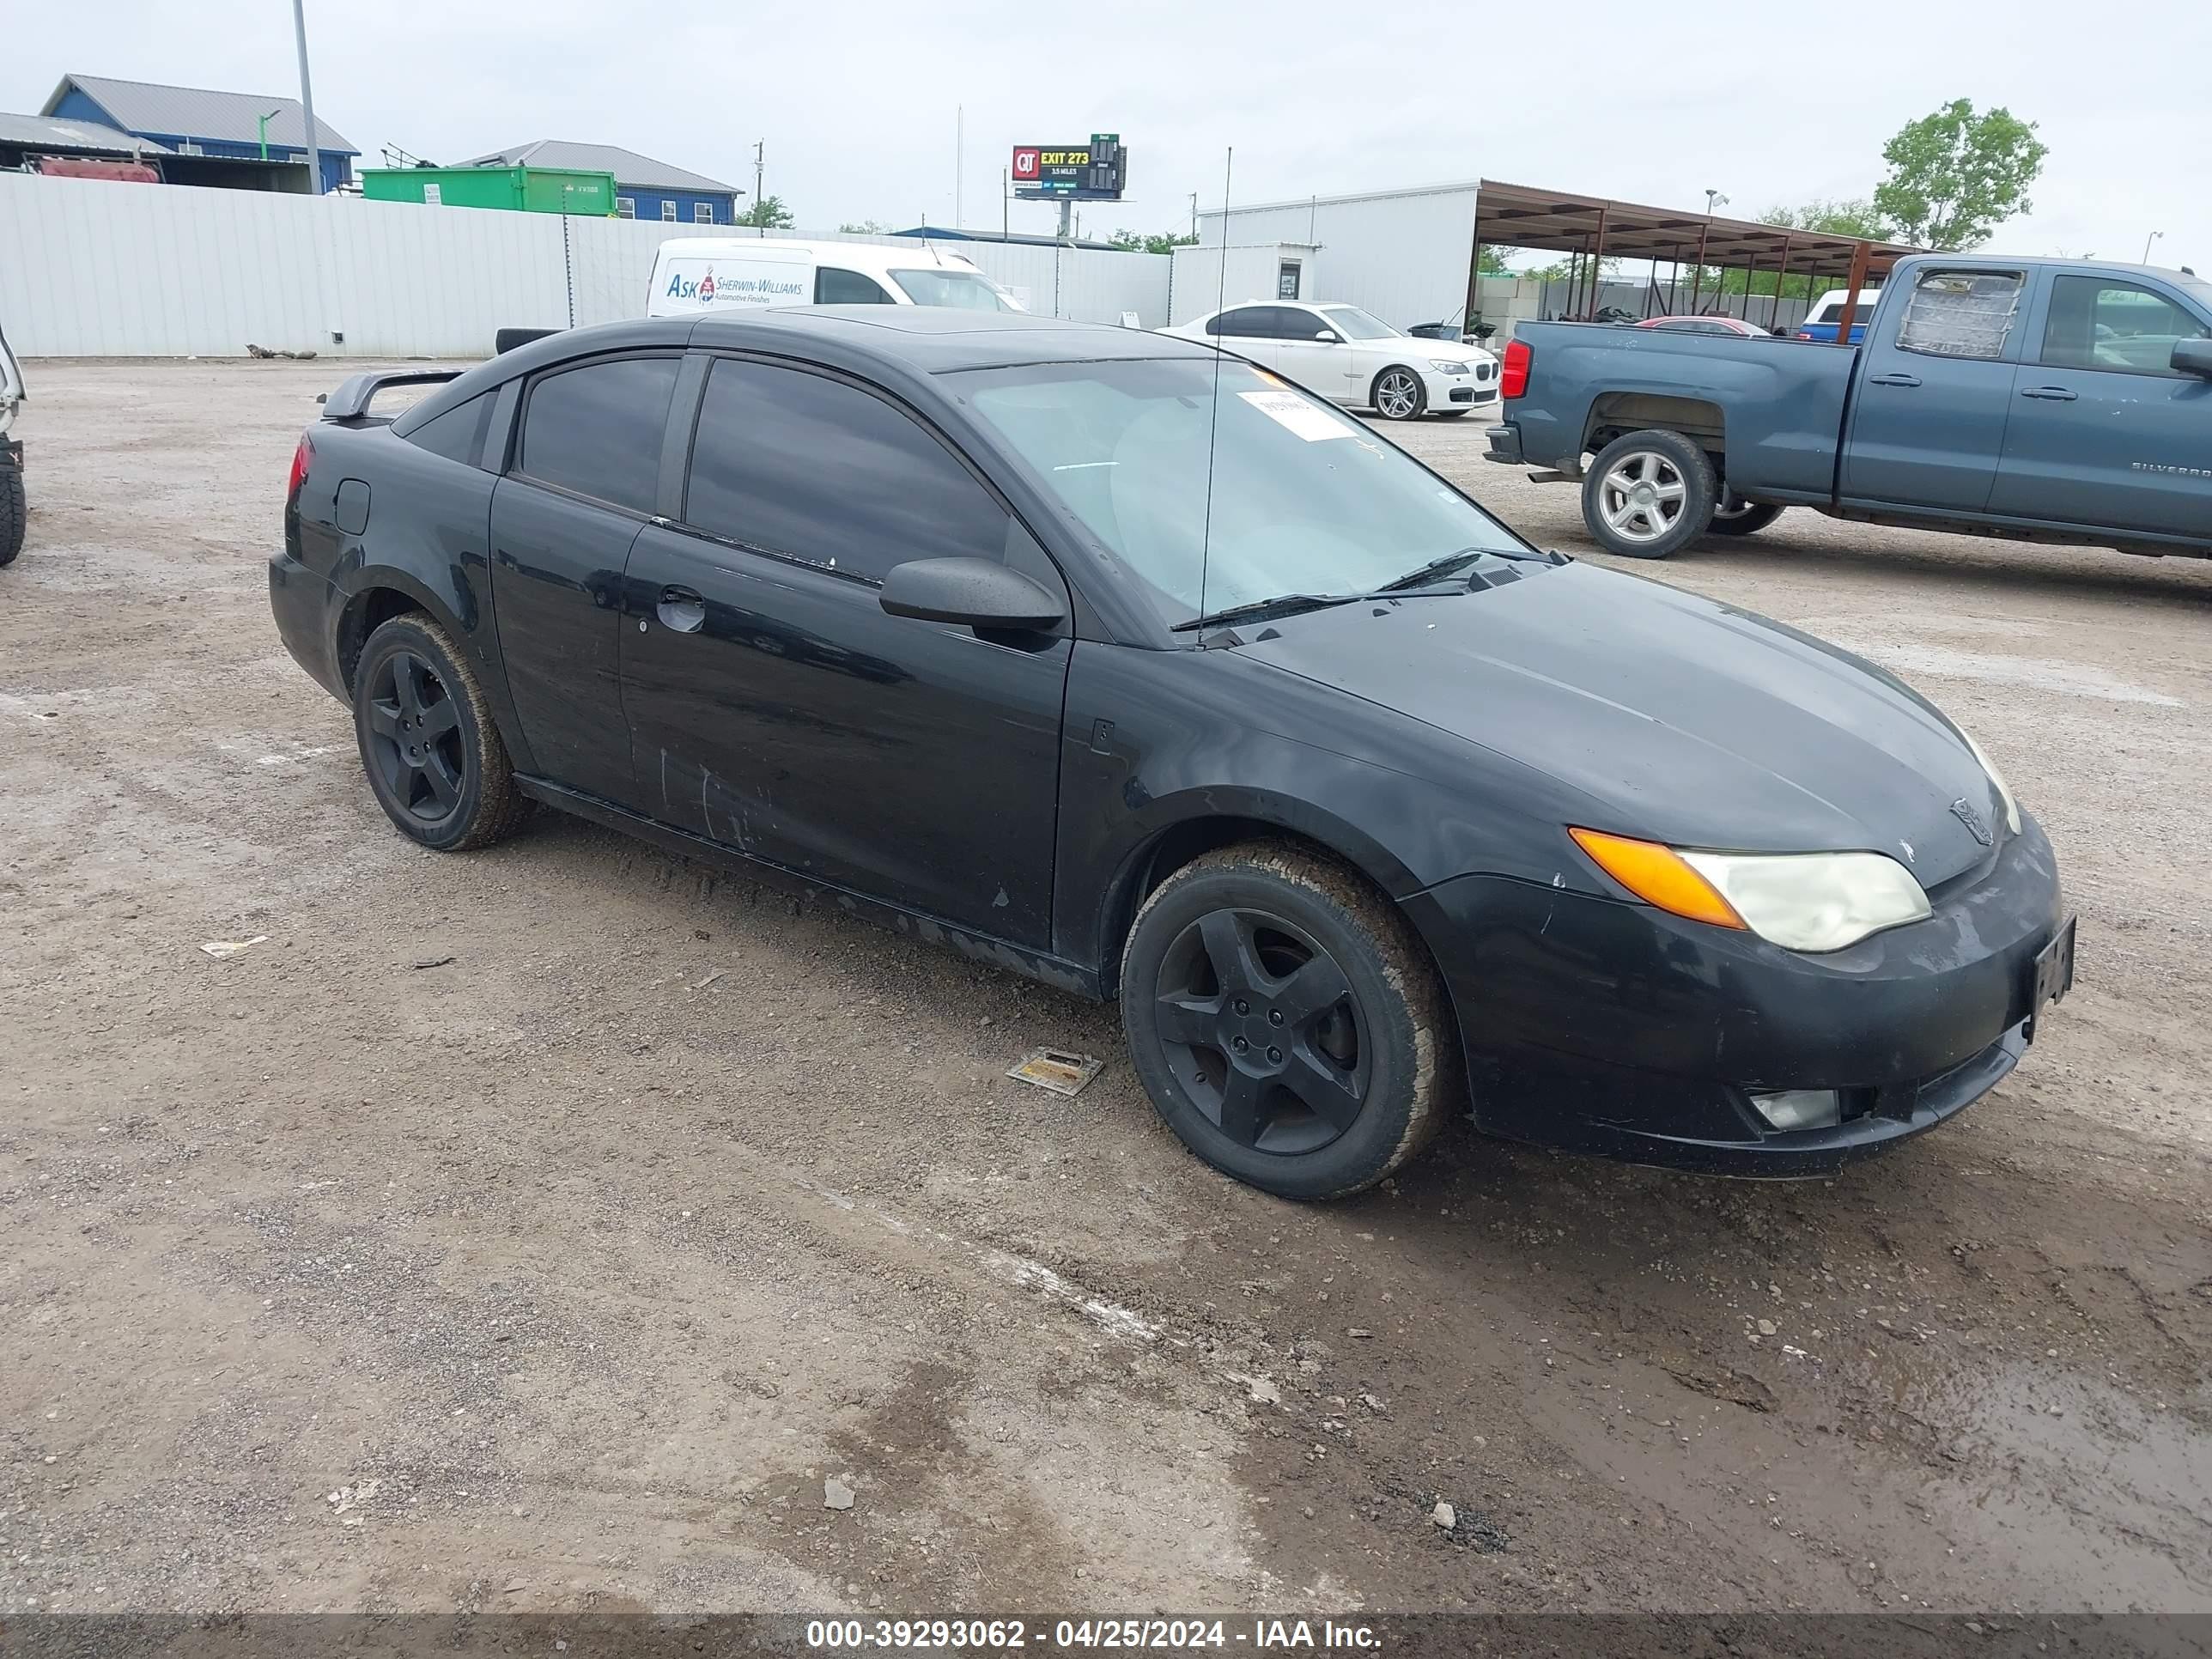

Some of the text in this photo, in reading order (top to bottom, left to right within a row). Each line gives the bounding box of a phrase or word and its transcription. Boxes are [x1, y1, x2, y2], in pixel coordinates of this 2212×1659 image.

[1017, 153, 1036, 173] QT
[1041, 152, 1090, 165] EXIT 273
[715, 293, 770, 304] Automotive Finishes
